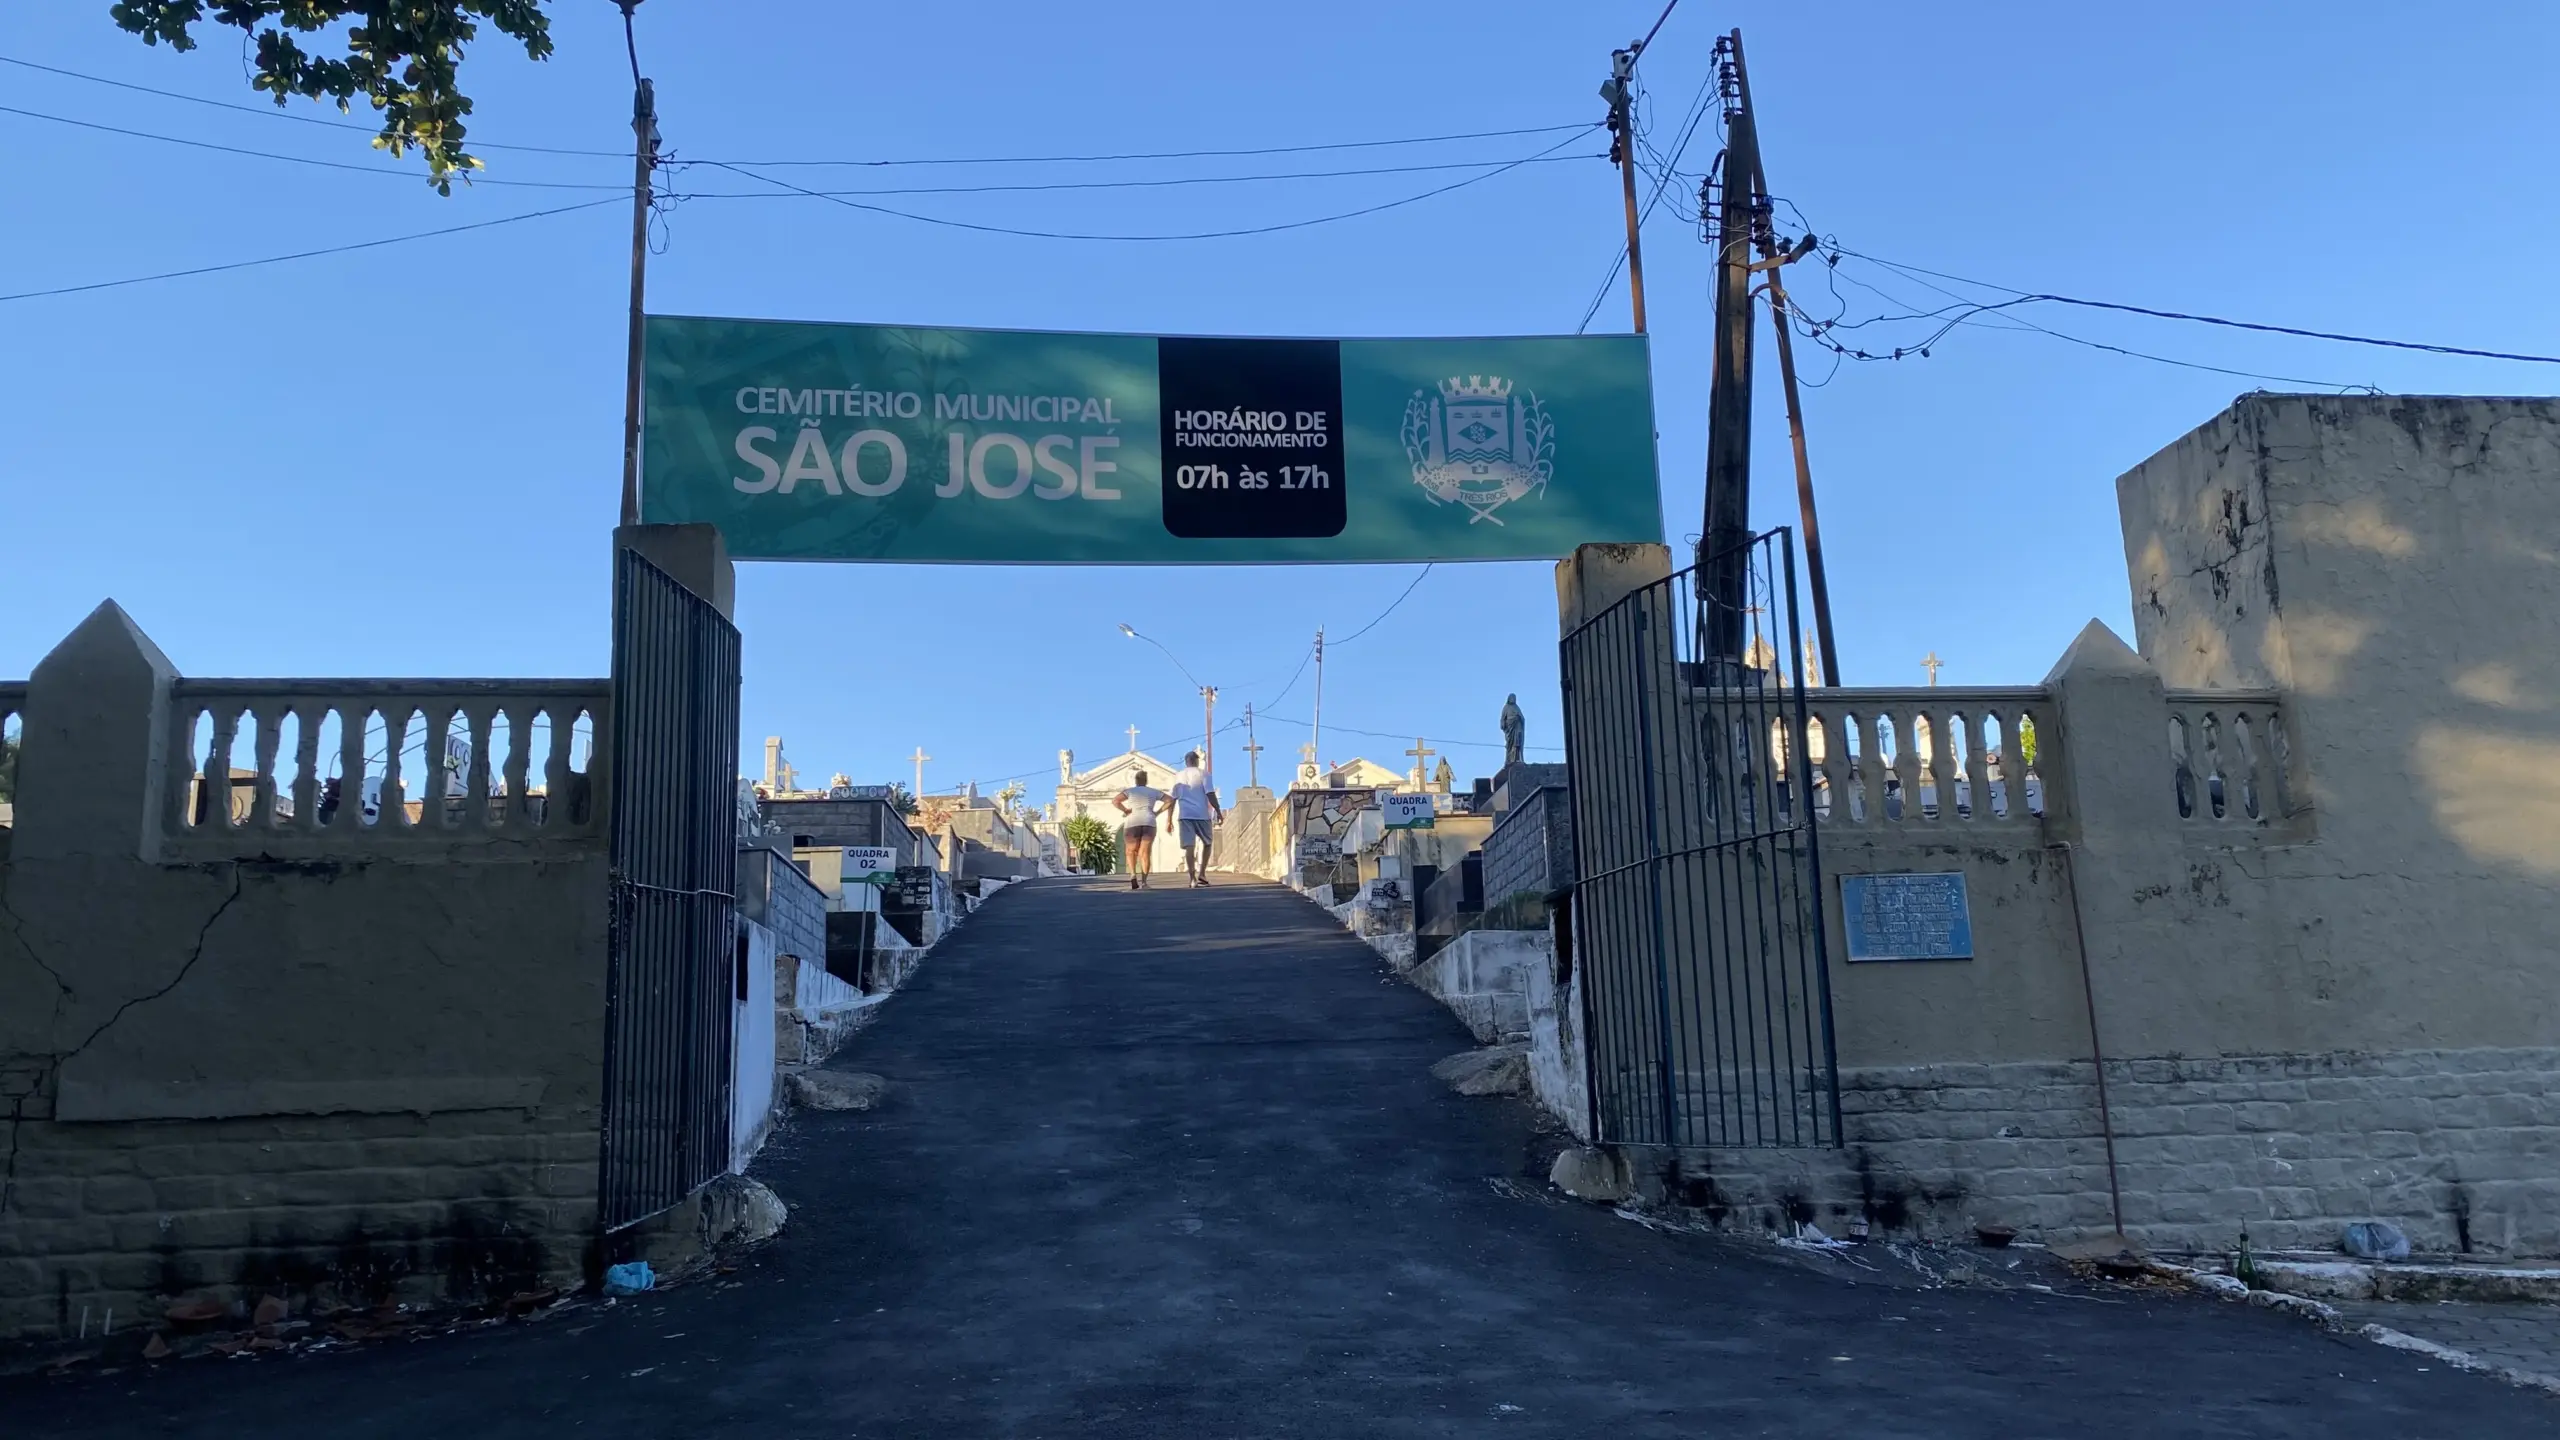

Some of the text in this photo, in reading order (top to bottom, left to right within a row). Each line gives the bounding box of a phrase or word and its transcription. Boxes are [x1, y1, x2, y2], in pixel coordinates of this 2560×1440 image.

[735, 383, 1122, 424] CEMITÉRIO MUNICIPAL
[1174, 406, 1327, 431] HORÁRIO DE
[1175, 432, 1328, 448] FUNCIONAMENTO
[733, 418, 1122, 500] SÃO JOSÉ
[1176, 464, 1330, 489] 07h às 17h
[1485, 490, 1508, 501] RIOS
[1389, 796, 1428, 805] QUADRA
[1402, 806, 1416, 816] 01
[848, 849, 890, 859] QUADRA
[860, 859, 877, 869] 02
